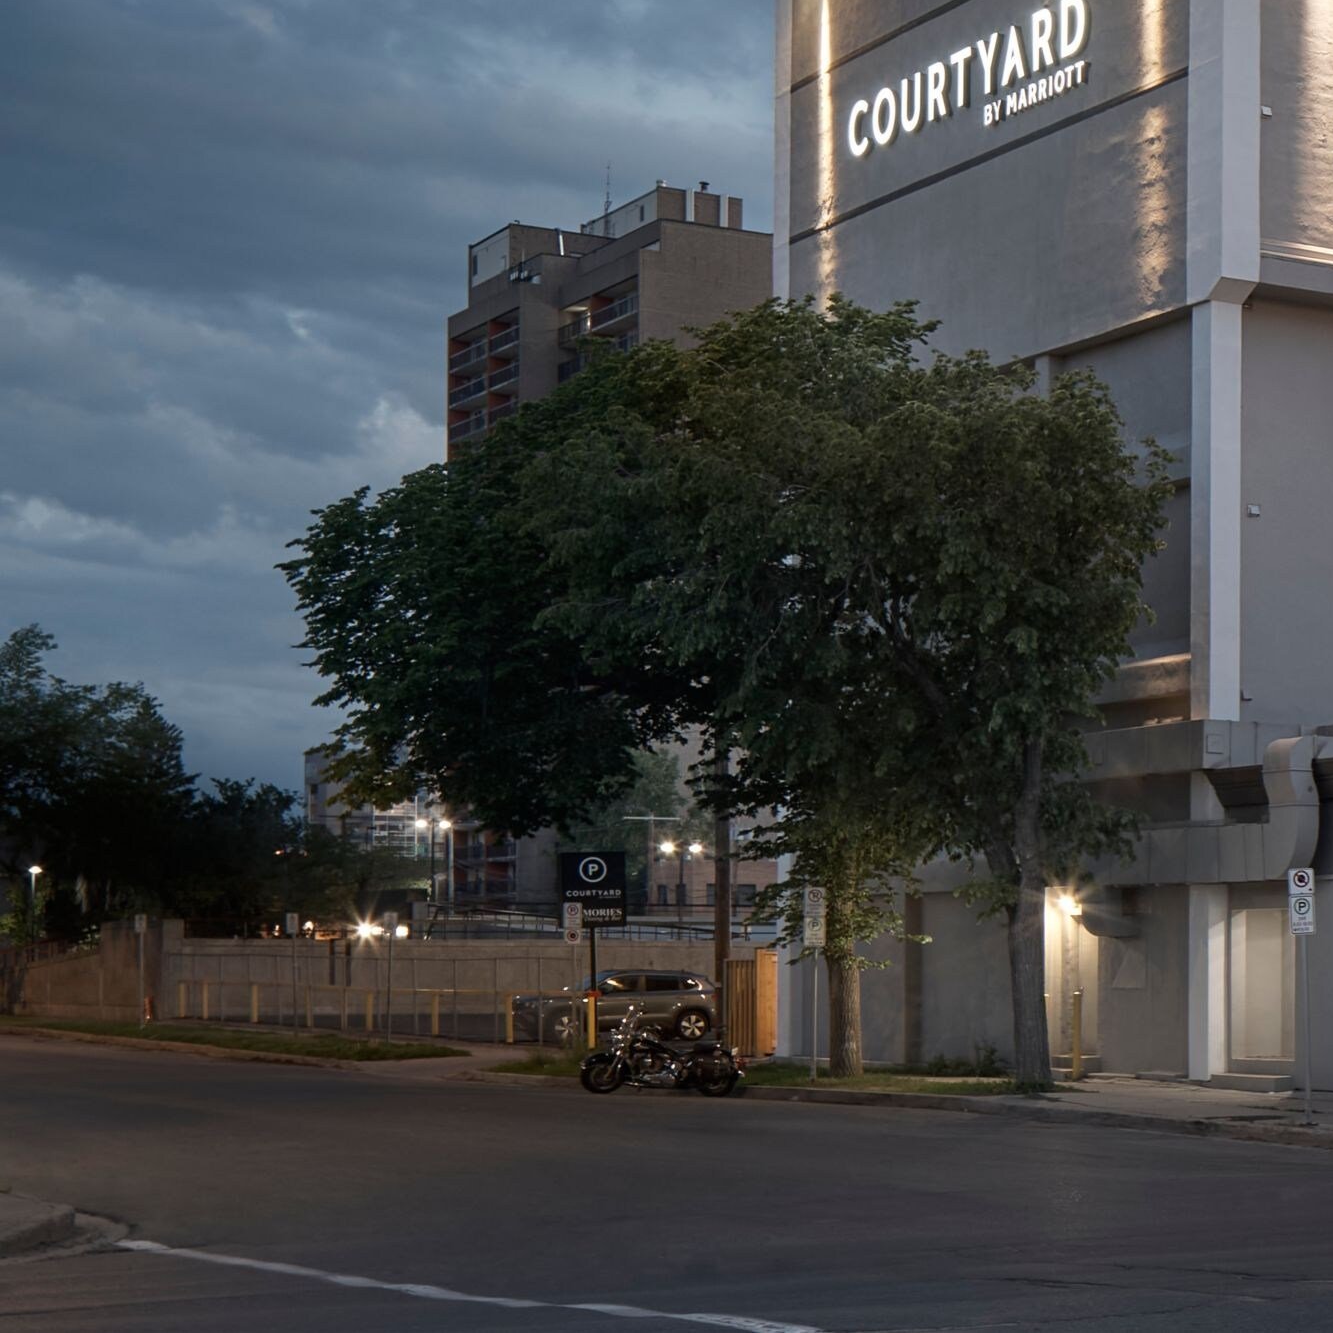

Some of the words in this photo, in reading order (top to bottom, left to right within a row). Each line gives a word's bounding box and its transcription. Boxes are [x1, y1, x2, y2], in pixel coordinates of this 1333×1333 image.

[984, 99, 1002, 126] BY
[1006, 60, 1086, 116] MARRIOTT
[566, 889, 622, 897] COURTYARD
[583, 908, 622, 917] MORIES
